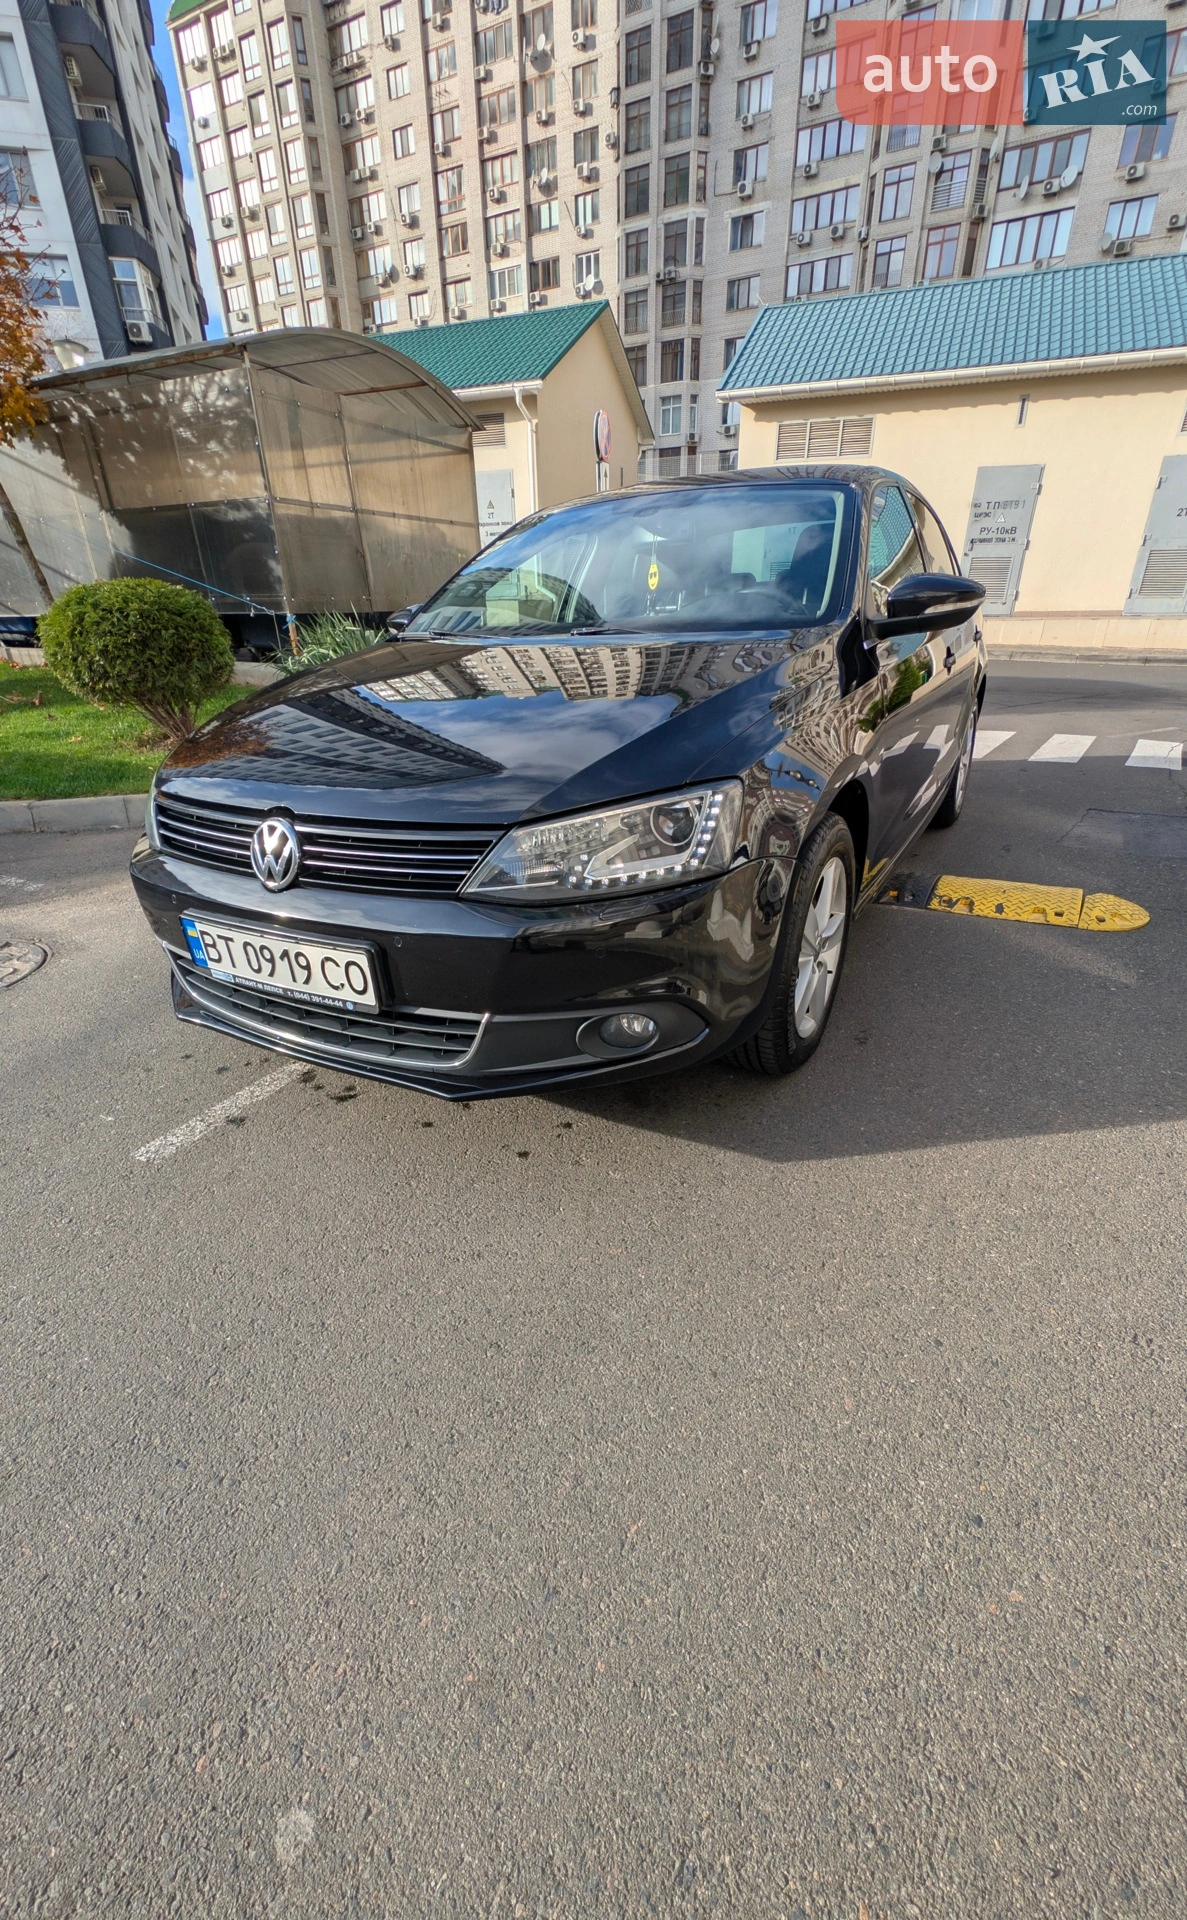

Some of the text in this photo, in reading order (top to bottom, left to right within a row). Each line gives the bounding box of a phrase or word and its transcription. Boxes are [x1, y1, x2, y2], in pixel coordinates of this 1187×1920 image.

[979, 526, 1018, 536] РУ-10кВ
[193, 948, 206, 961] UA
[199, 930, 369, 997] BT 0919 CO
[293, 990, 311, 1002] (044)
[311, 994, 344, 1008] 391-44-44
